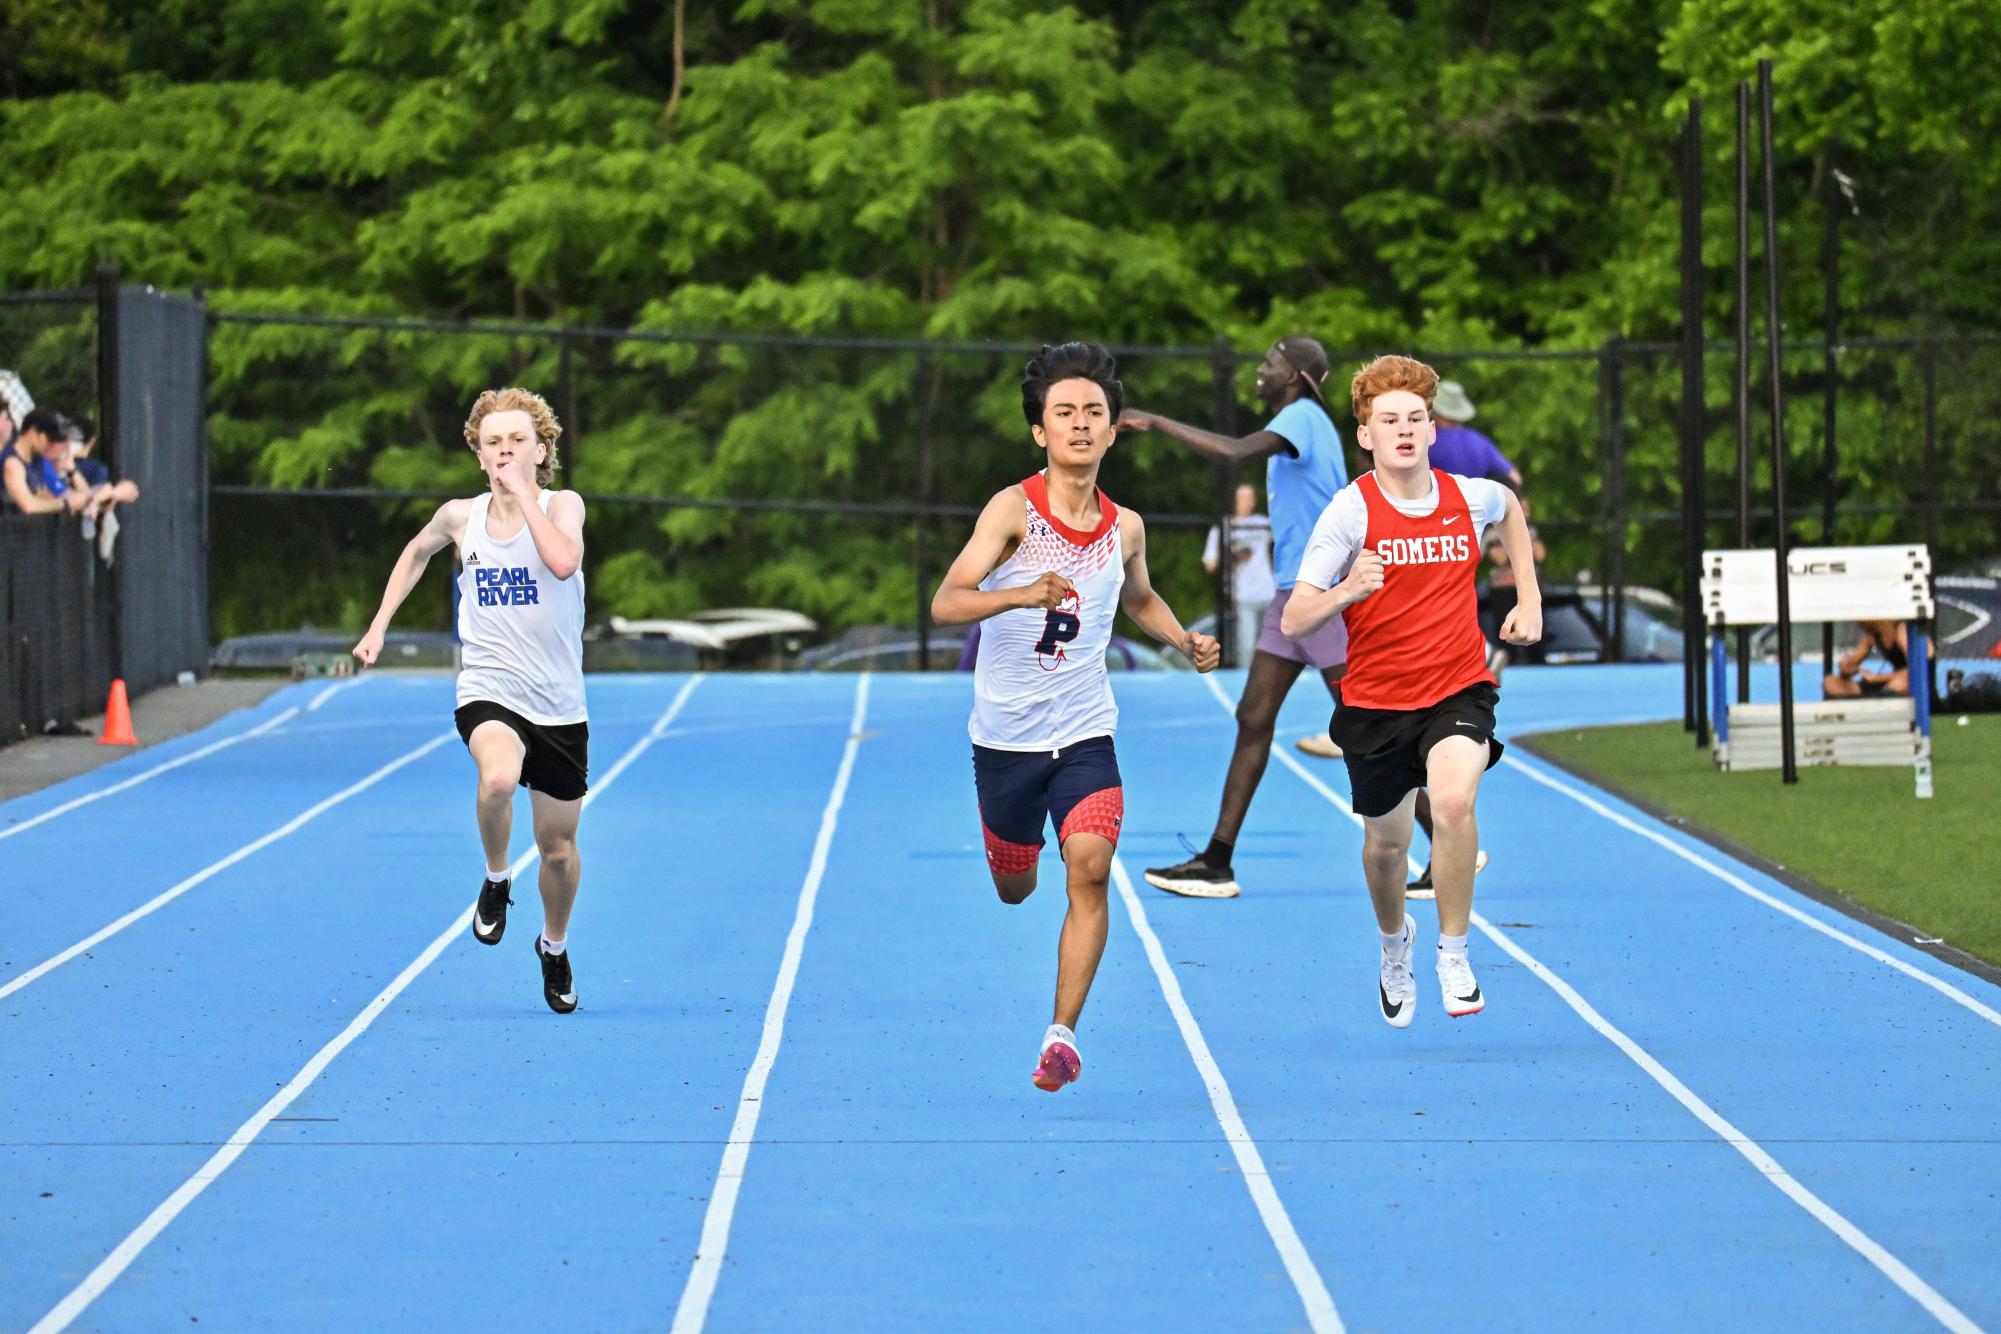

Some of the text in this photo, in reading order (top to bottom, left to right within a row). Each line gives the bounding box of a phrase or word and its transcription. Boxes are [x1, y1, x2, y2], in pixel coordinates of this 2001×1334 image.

[1377, 535, 1469, 565] SOMERS
[475, 567, 537, 586] PEARL
[478, 586, 539, 606] RIVER
[1034, 610, 1081, 656] P
